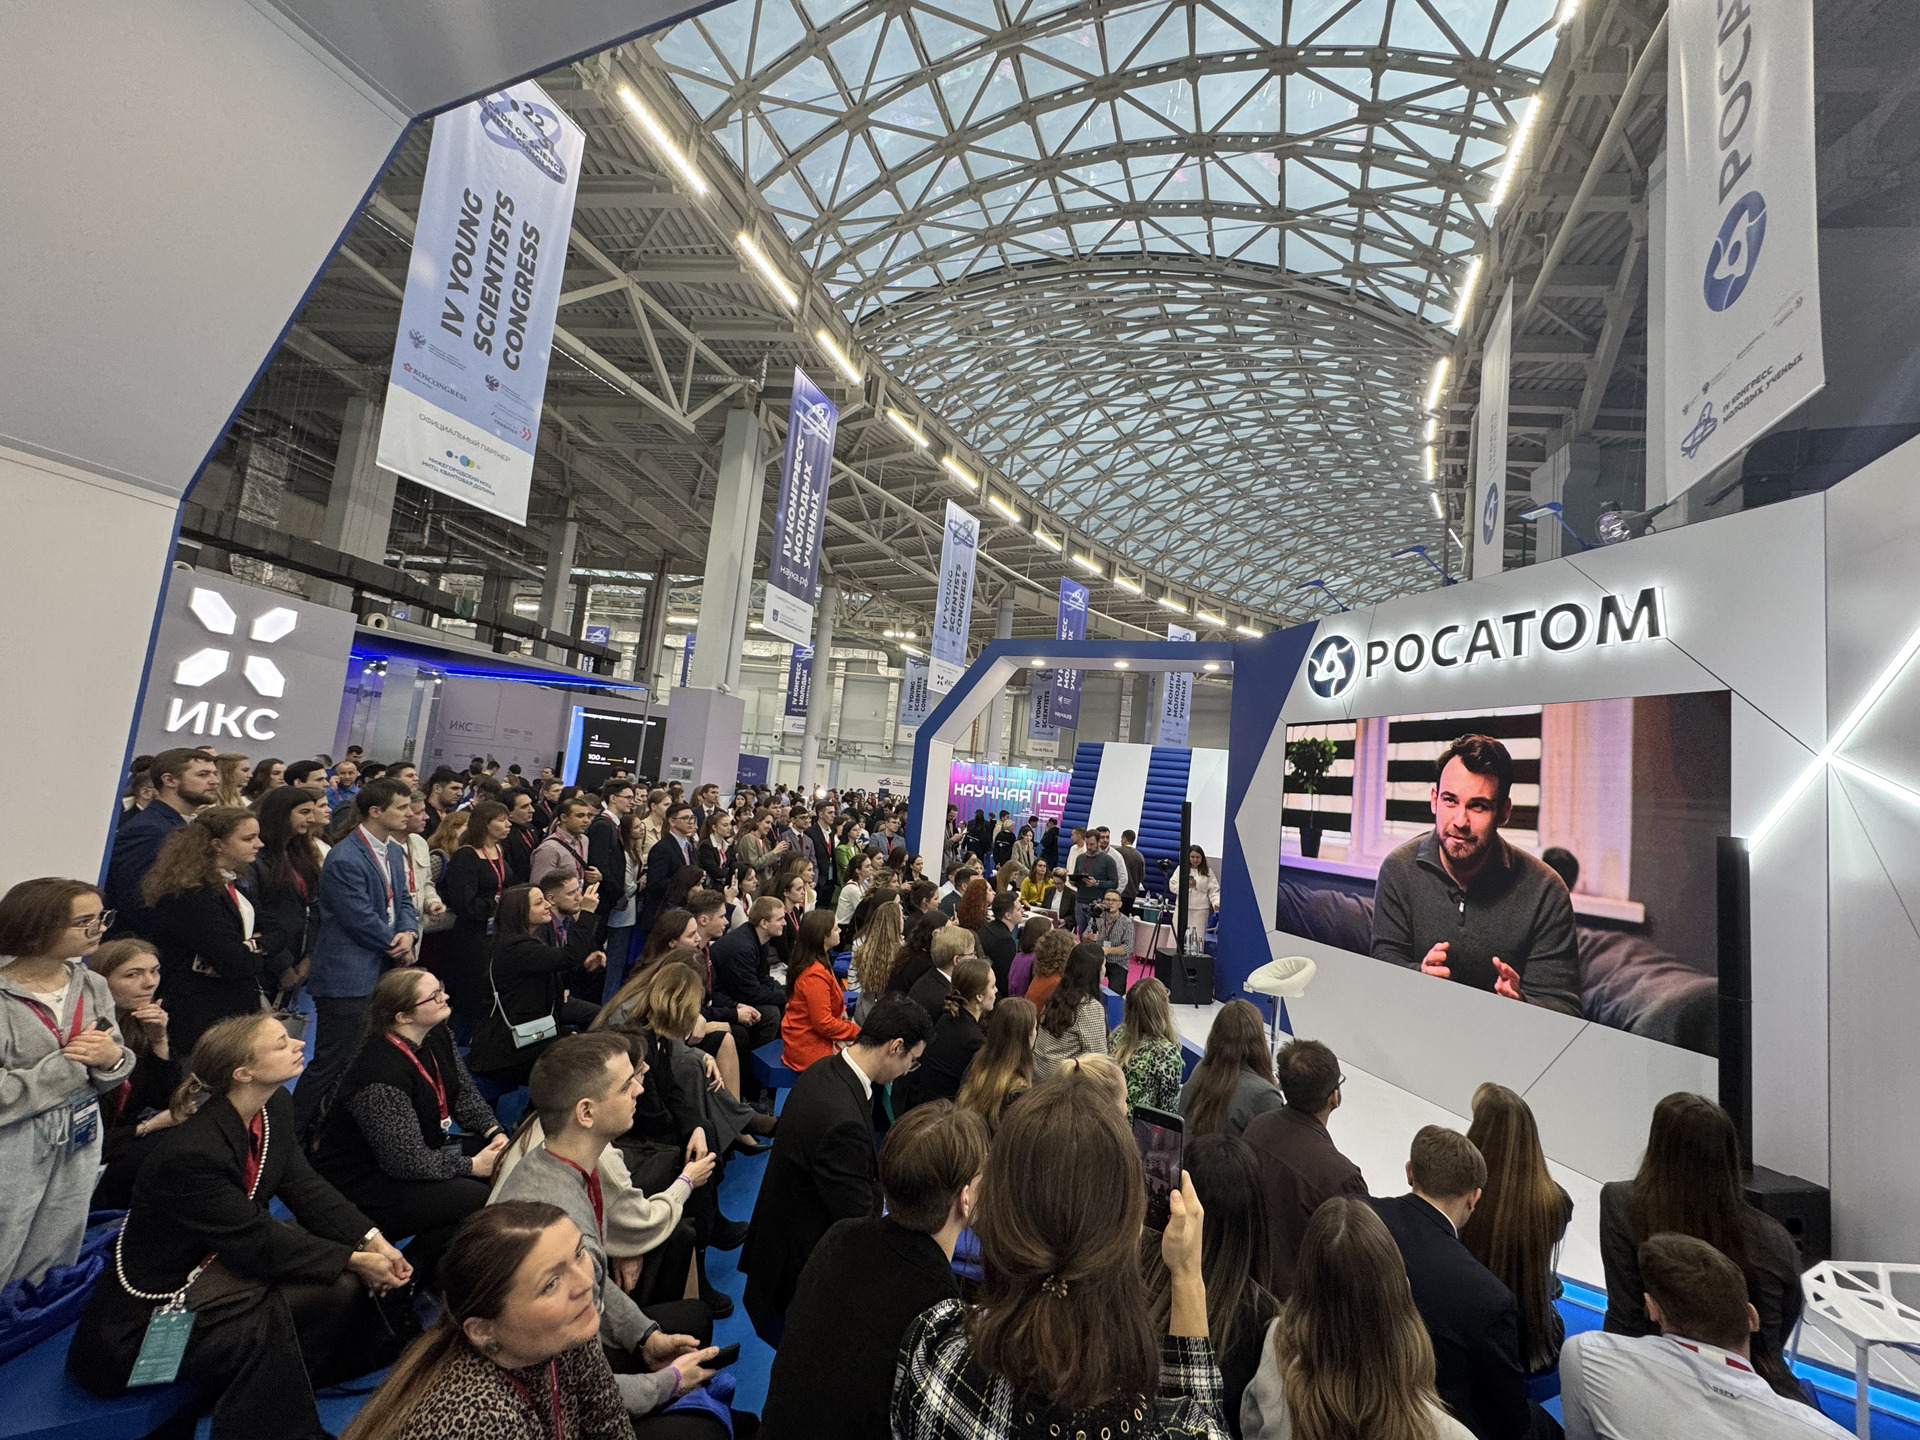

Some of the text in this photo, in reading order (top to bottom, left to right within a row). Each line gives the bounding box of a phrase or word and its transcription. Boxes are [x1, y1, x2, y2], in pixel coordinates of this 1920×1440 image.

[483, 96, 564, 175] ECADE OF SCIENCE
[484, 107, 564, 180] AND TECHNOLOGY
[441, 188, 482, 338] IV YOUNG
[474, 190, 514, 356] SCIENTISTS
[503, 220, 540, 370] CONGRESS
[413, 368, 468, 402] ROSCONGRESS
[1722, 386, 1764, 424] МОЛОДЫХ
[1766, 352, 1803, 390] УЧЕНЫХ
[1722, 404, 1731, 413] IV
[1731, 365, 1774, 406] КОНГРЕСС
[418, 413, 480, 449] ОФИЦИАЛЬНЫЙ
[480, 443, 511, 462] ПАРТНЕР
[783, 436, 804, 558] IV КОНГРЕСС
[793, 462, 812, 564] МОЛОДЫХ
[804, 489, 820, 569] УЧЕНЫХ
[780, 565, 808, 588] наука.рф
[942, 570, 953, 630] IV YOUNG
[949, 563, 962, 633] SCIENTISTS
[956, 572, 968, 635] CONGRESS
[1366, 587, 1663, 679] РОСАТОМ
[794, 662, 802, 696] КОНГРЕСС
[799, 670, 808, 705] МОЛОДЫХ
[914, 677, 922, 712] SCIENTISTS
[1042, 690, 1050, 728] SCIENTISTS
[1057, 675, 1063, 687] IV
[166, 698, 280, 740] ИКС
[450, 720, 472, 732] ИКС
[954, 783, 1031, 802] НАУЧНАЯ
